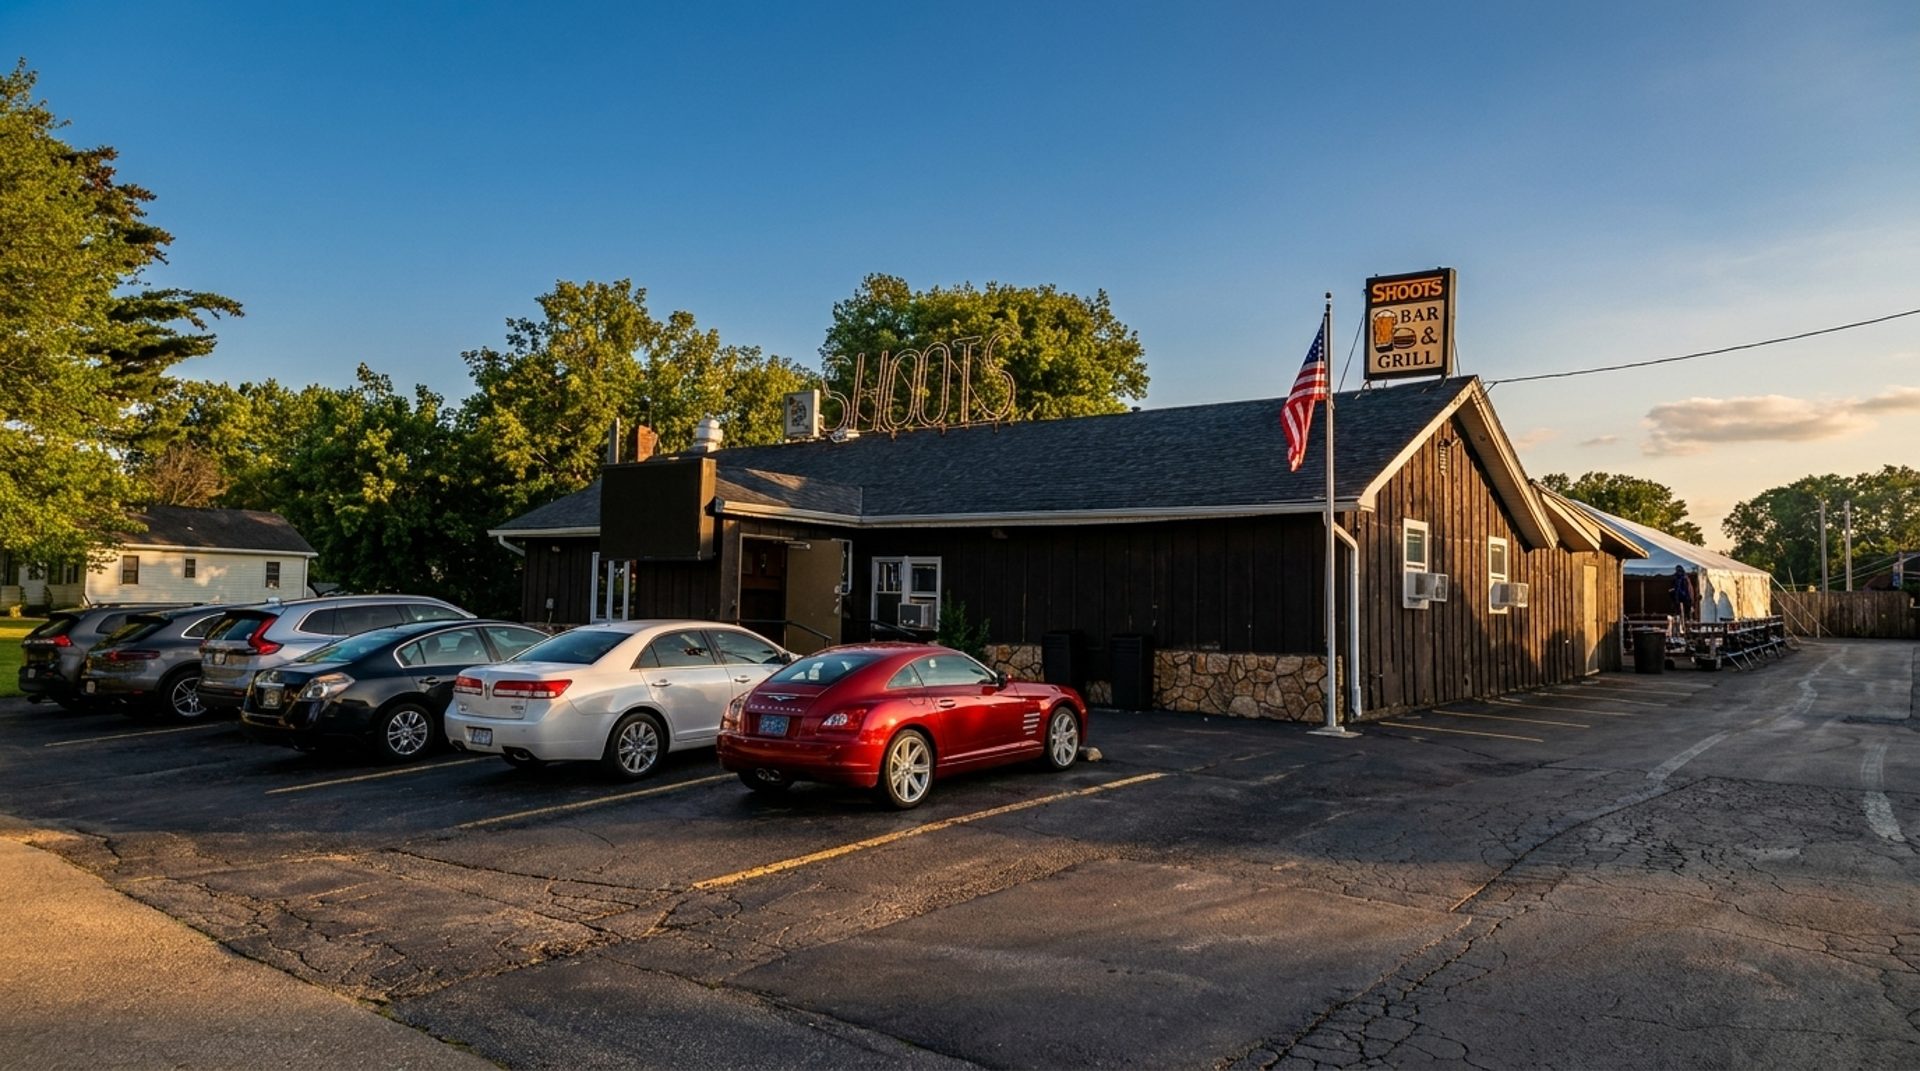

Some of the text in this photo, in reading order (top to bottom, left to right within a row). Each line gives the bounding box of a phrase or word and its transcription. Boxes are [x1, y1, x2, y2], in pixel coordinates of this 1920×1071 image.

[1372, 280, 1443, 303] SHOOTS
[1401, 306, 1439, 323] BAR
[1421, 326, 1437, 345] &
[1377, 351, 1436, 369] GRILL
[821, 326, 1020, 432] SHOOTS
